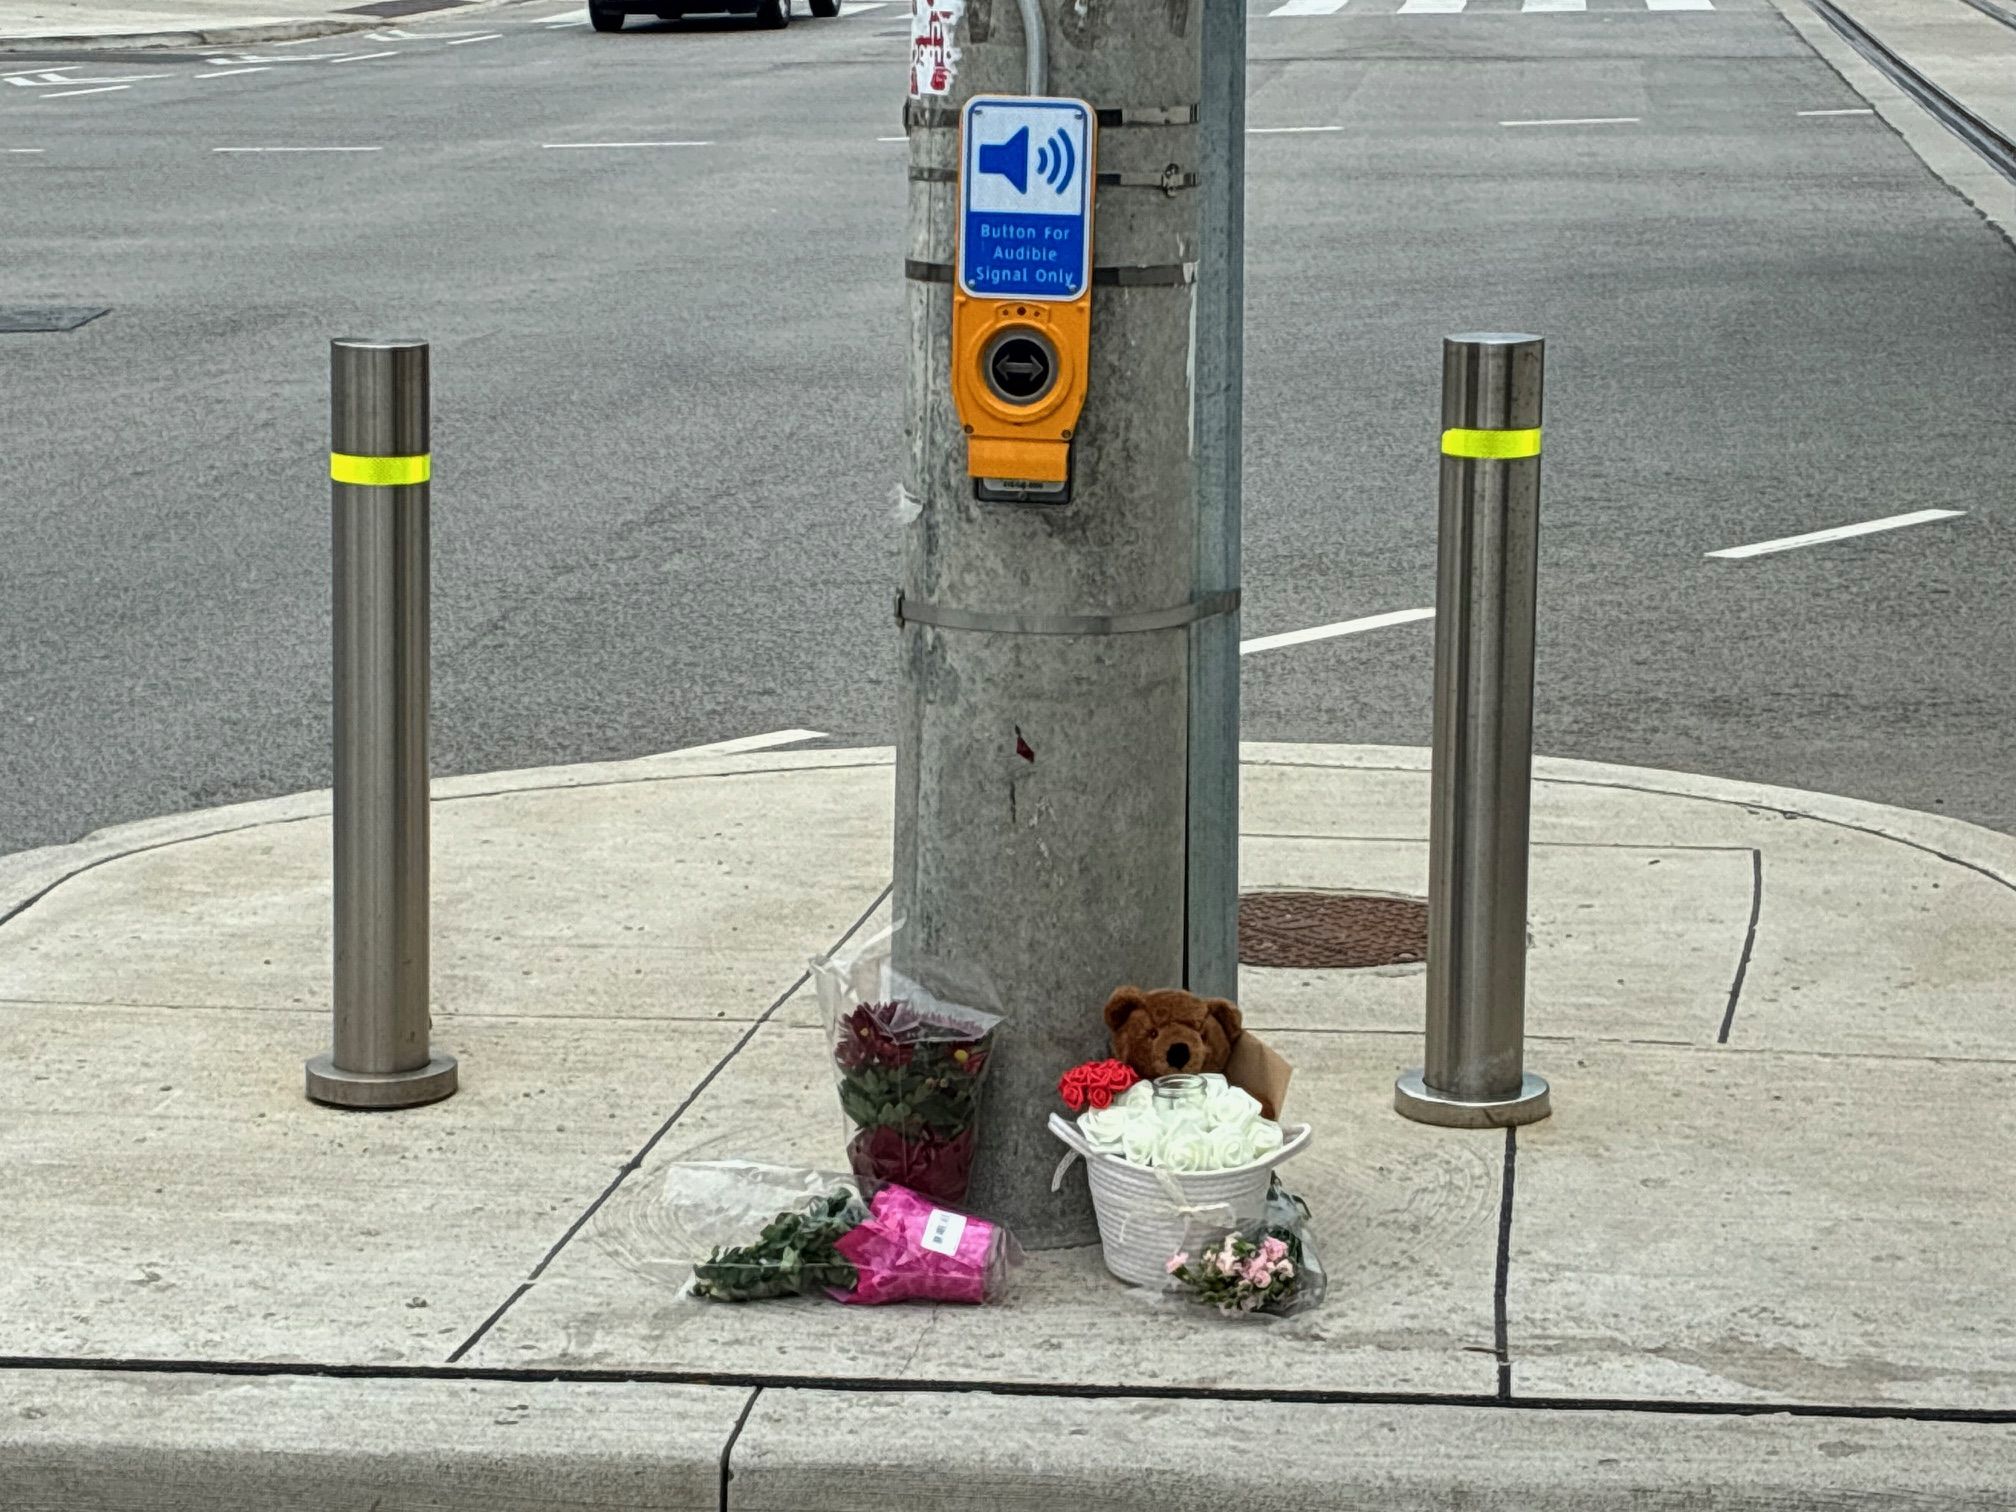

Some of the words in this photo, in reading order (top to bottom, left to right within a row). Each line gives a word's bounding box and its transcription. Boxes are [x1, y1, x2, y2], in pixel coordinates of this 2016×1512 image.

[981, 223, 1036, 239] Button
[1044, 226, 1070, 240] For
[993, 245, 1058, 261] Audible
[976, 265, 1028, 285] Signal
[1035, 268, 1073, 287] Only
